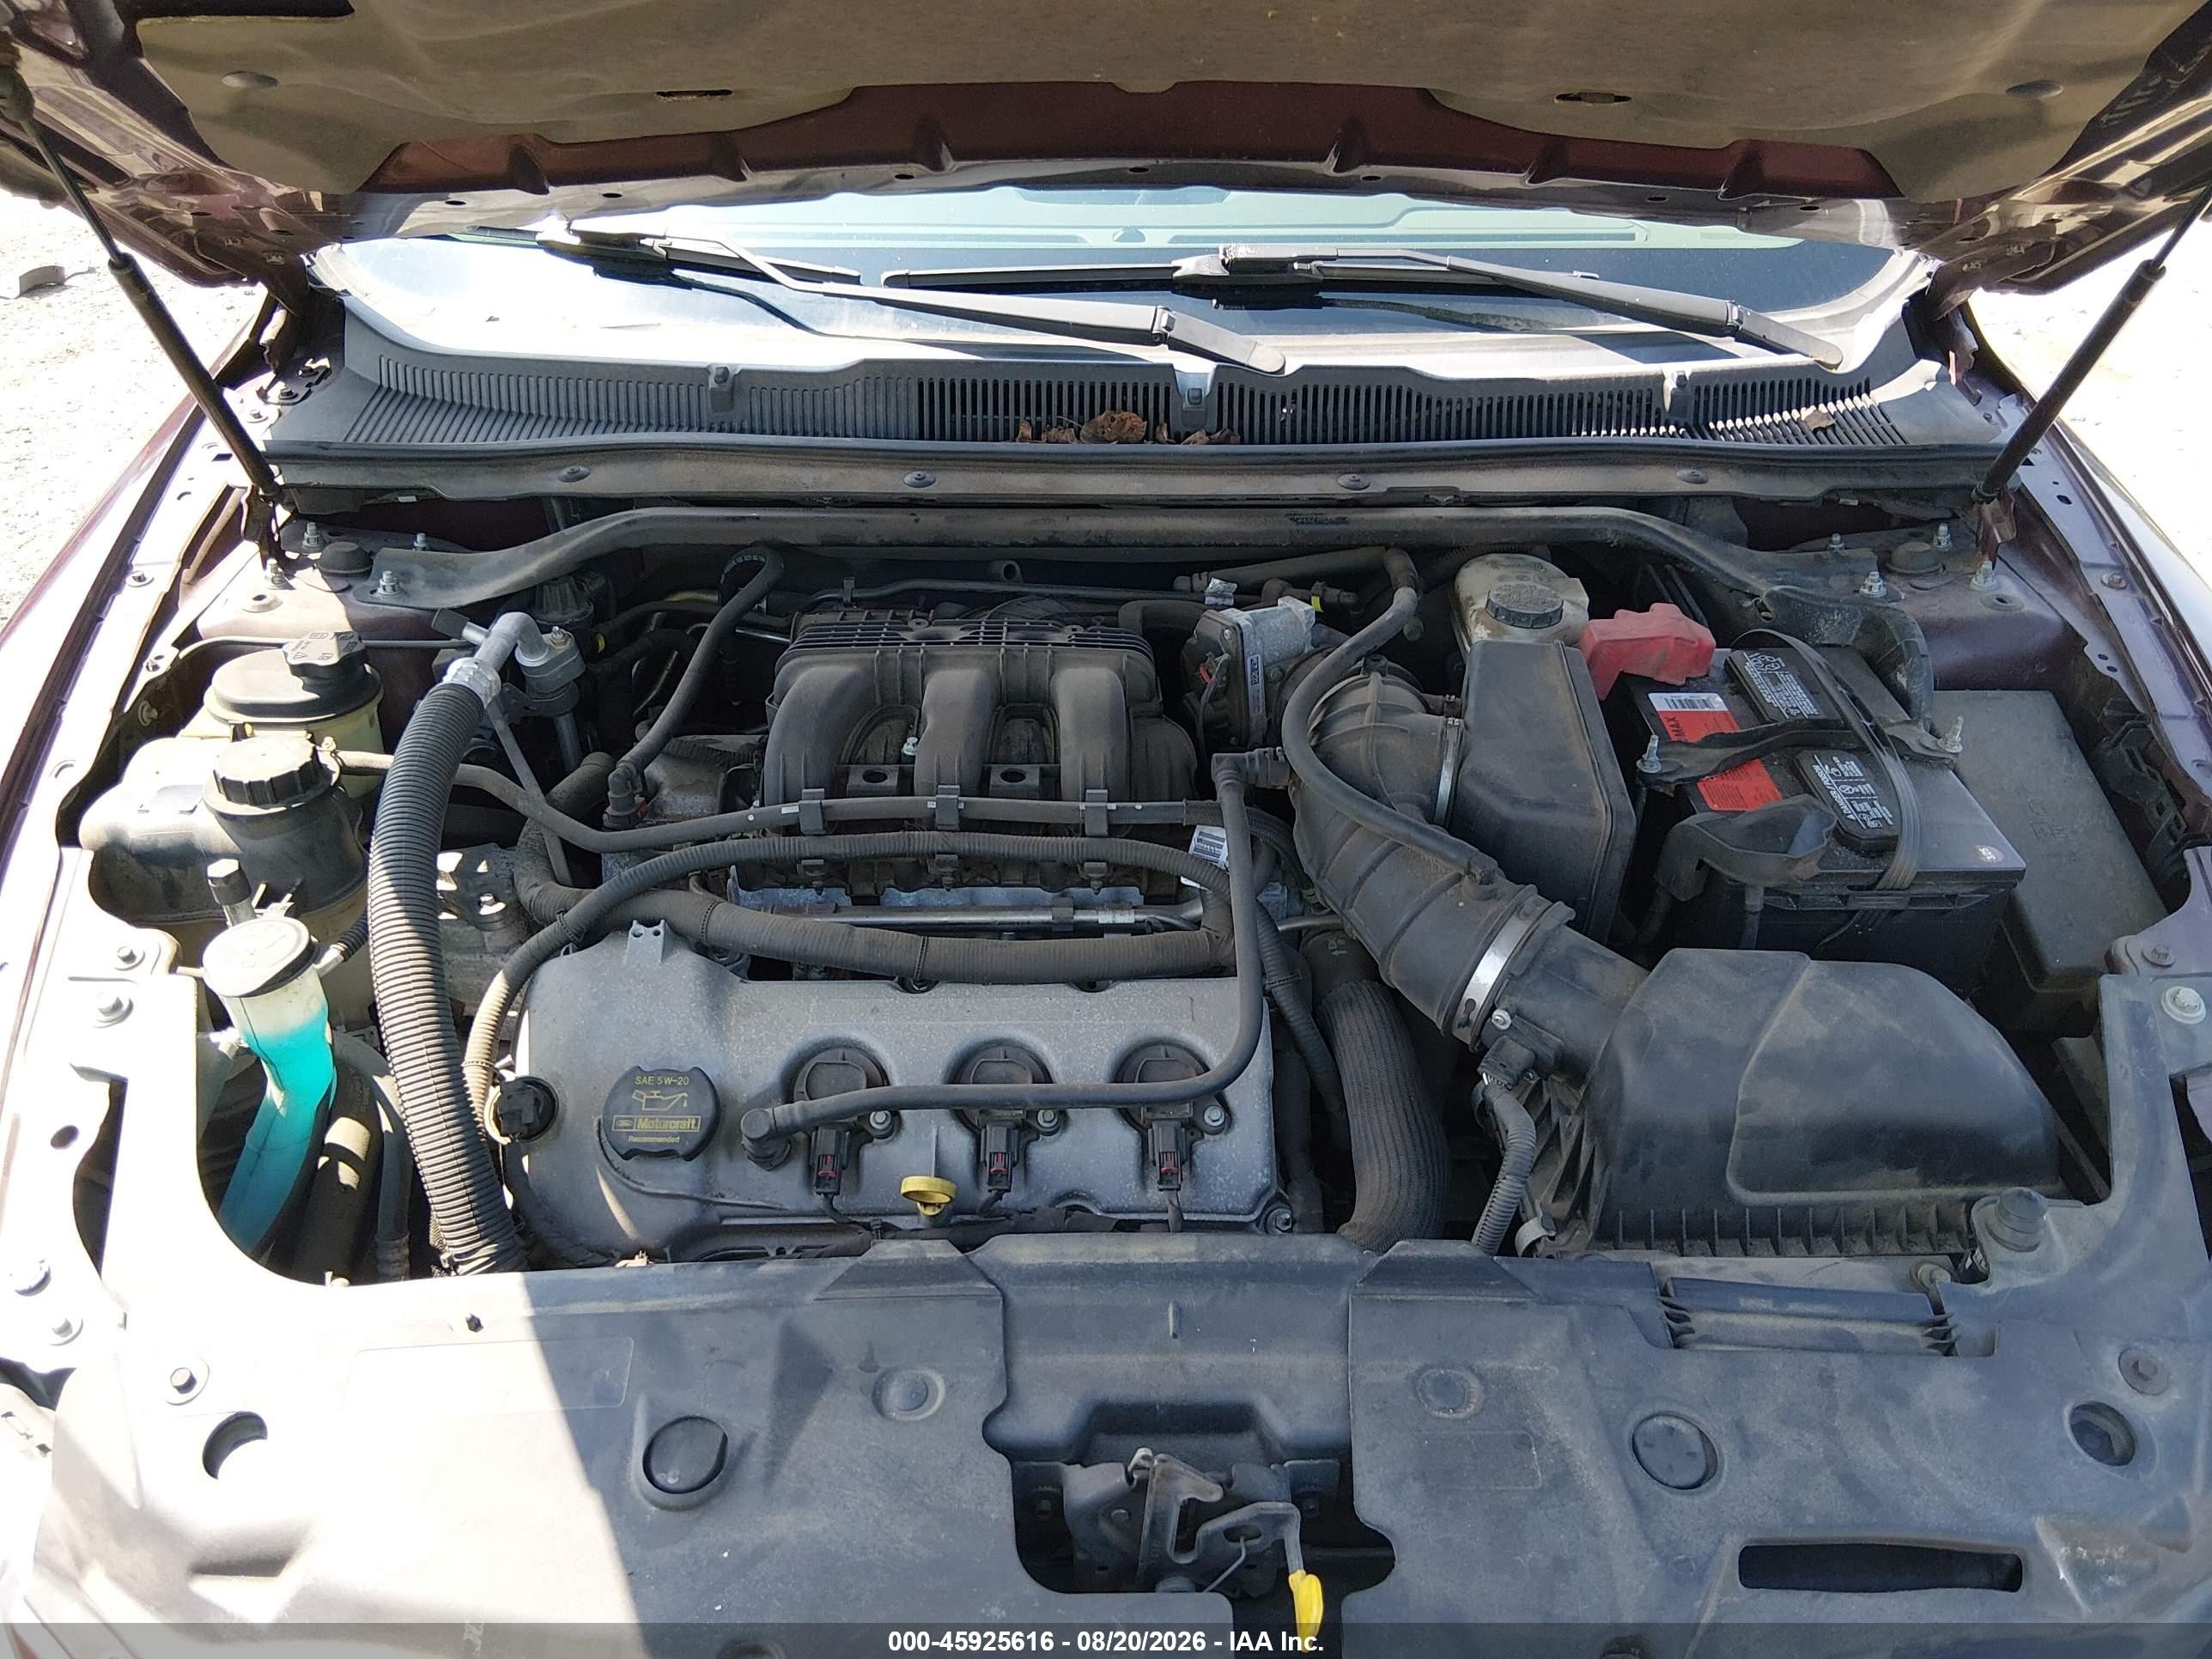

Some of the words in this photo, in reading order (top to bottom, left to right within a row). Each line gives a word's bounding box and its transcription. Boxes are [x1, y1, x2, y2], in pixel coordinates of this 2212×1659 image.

[635, 1076, 654, 1085] SAE
[657, 1076, 690, 1086] 5W-20
[637, 1117, 696, 1130] Motorcraft
